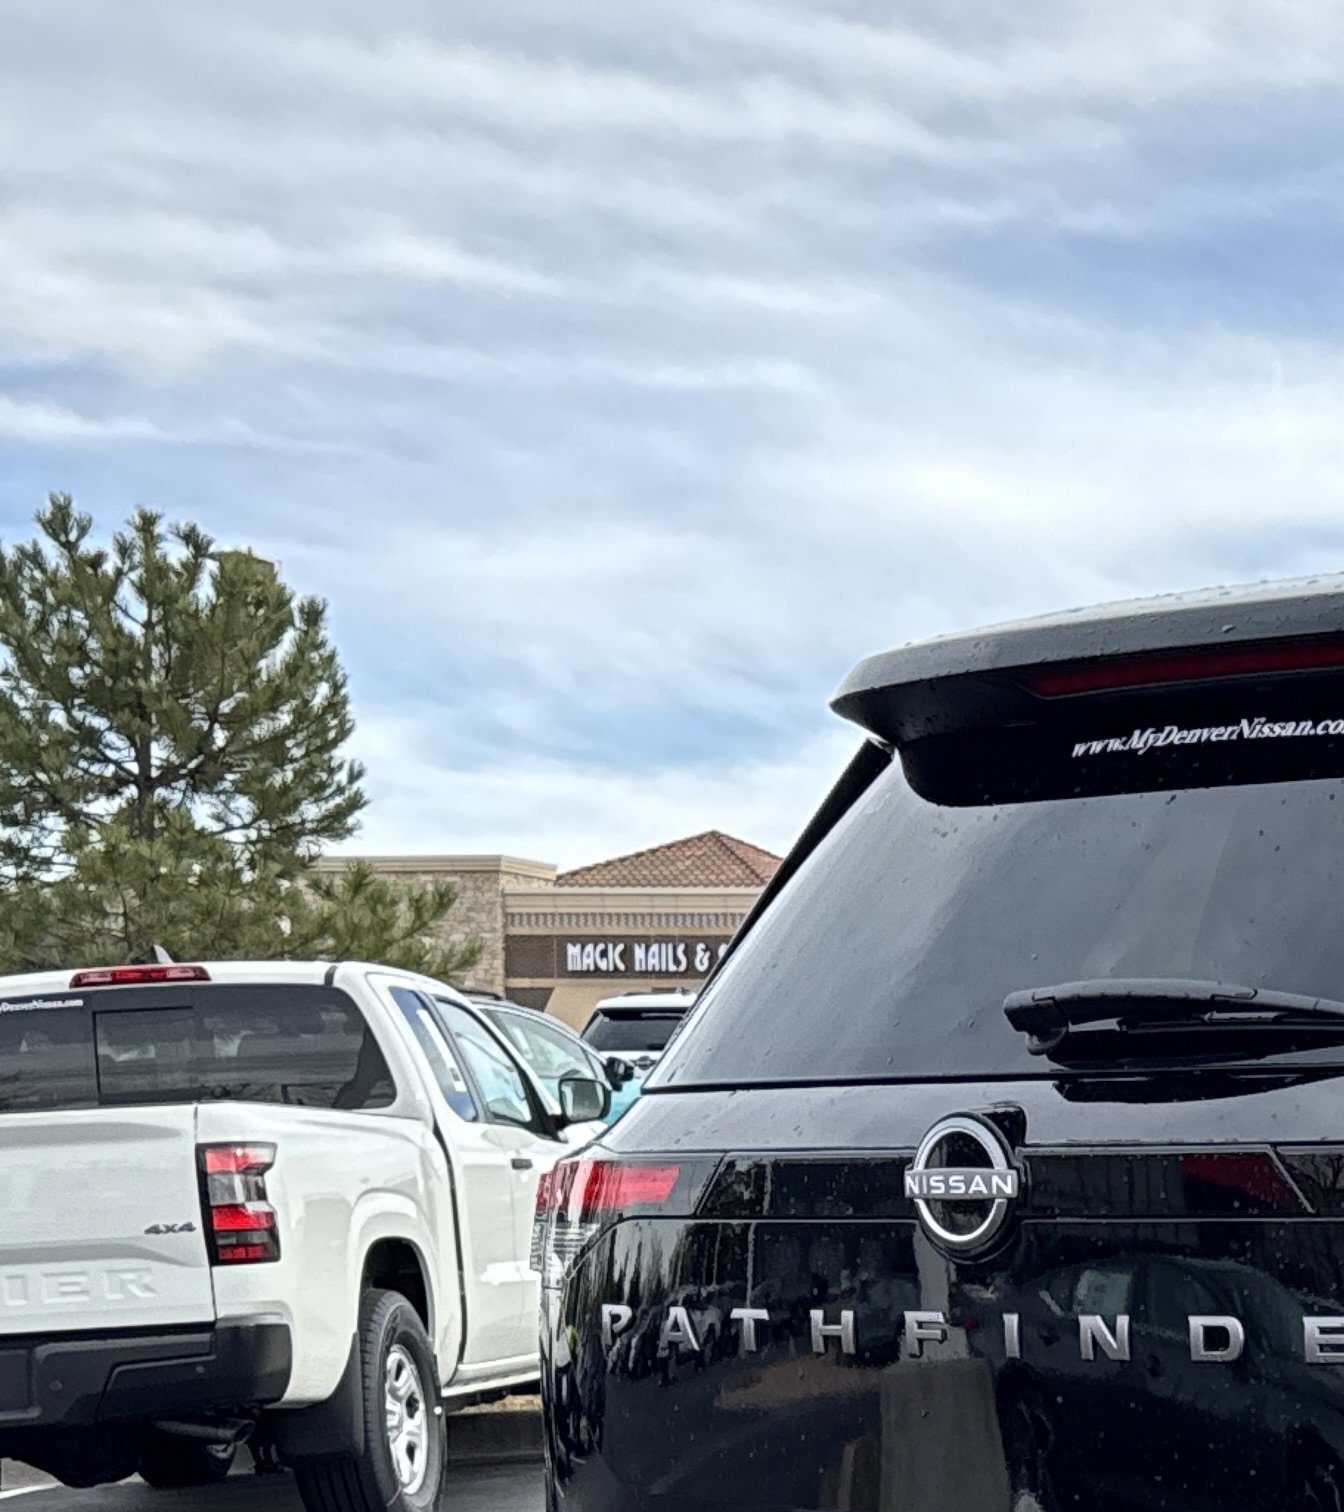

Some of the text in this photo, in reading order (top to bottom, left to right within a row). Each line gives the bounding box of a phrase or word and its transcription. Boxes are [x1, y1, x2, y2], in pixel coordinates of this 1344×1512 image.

[566, 942, 626, 972] MAGIC
[634, 942, 688, 972] NAILS
[694, 942, 711, 972] &
[906, 1174, 1013, 1195] NISSAN
